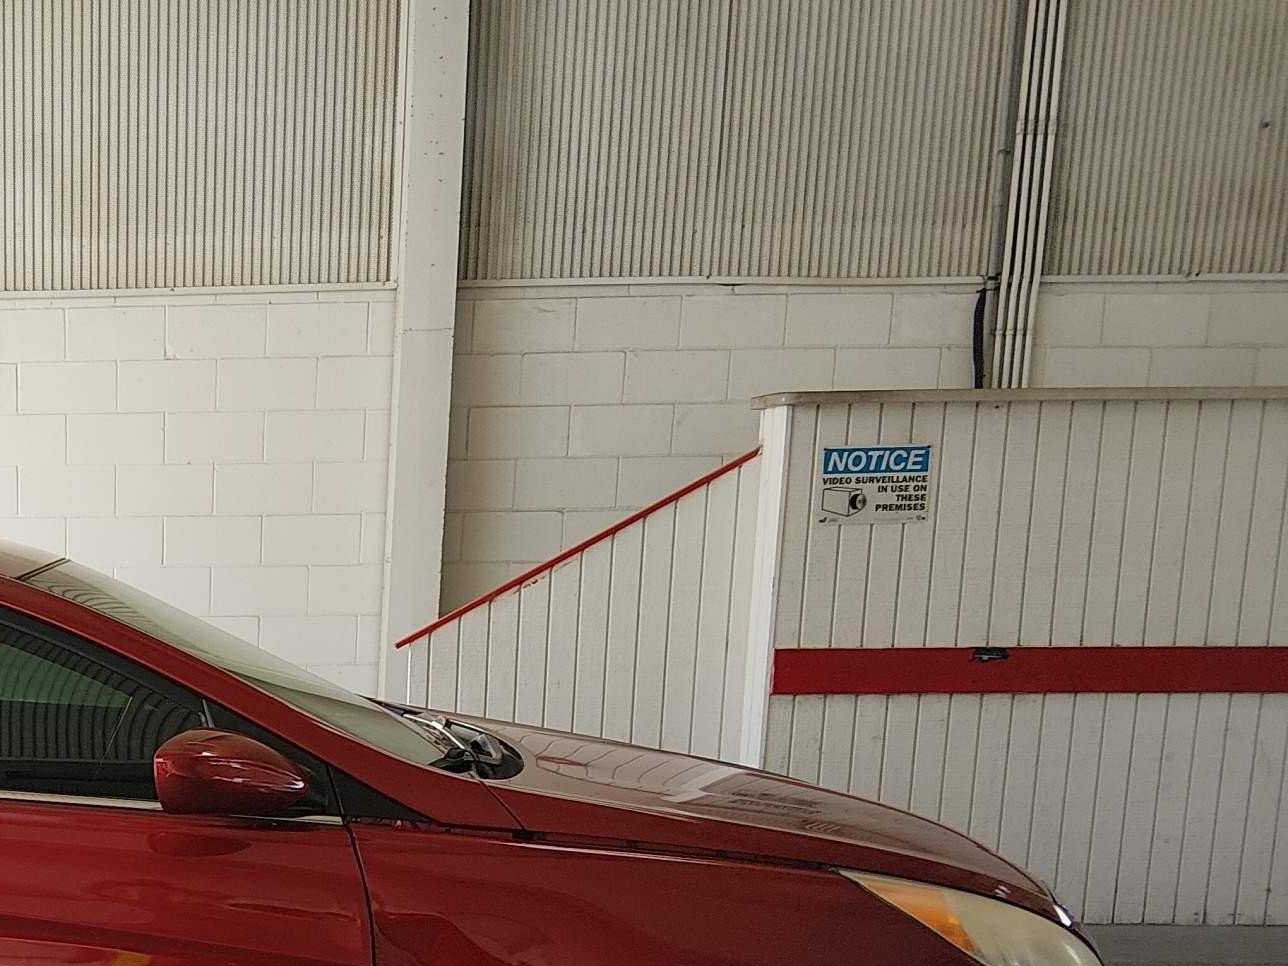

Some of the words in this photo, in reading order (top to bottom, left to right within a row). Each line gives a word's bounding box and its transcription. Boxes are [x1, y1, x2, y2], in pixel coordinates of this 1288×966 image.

[827, 450, 926, 471] NOTICE
[822, 477, 852, 485] VIDEO
[855, 475, 928, 484] SURVEILLANCE
[877, 485, 888, 493] IN
[913, 484, 927, 492] ON
[875, 503, 925, 511] PREMISES
